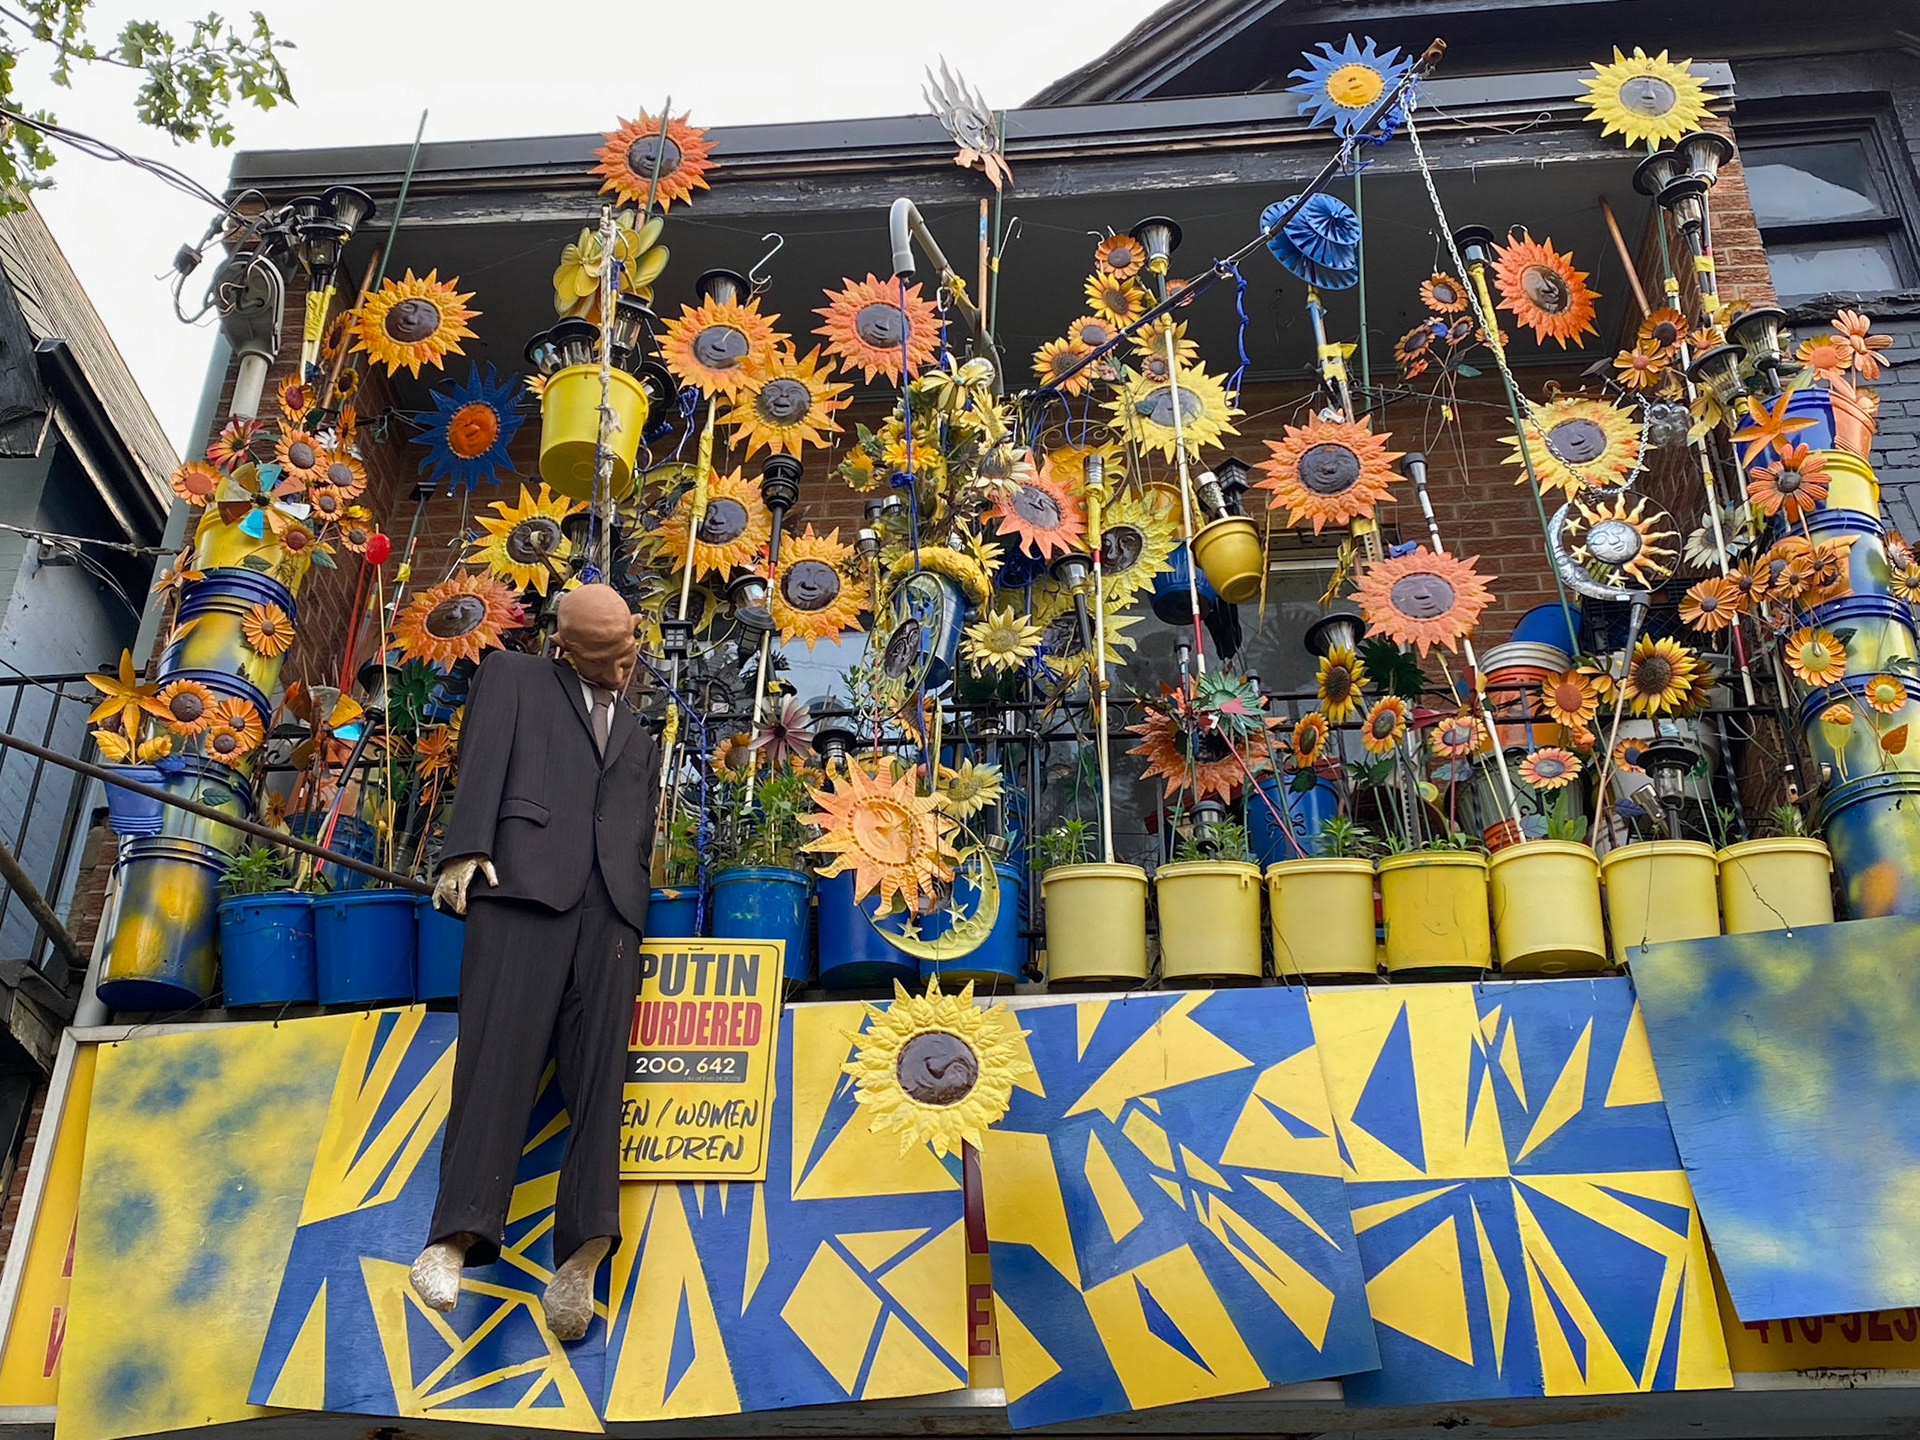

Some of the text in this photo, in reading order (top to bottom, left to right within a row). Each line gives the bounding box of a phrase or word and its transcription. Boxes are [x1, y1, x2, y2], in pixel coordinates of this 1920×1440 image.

[639, 953, 760, 996] PUTIN
[635, 1057, 736, 1076] 200, 642
[621, 1099, 650, 1128] EN
[675, 1099, 758, 1129] WOMEN
[620, 1135, 744, 1162] HILDREN
